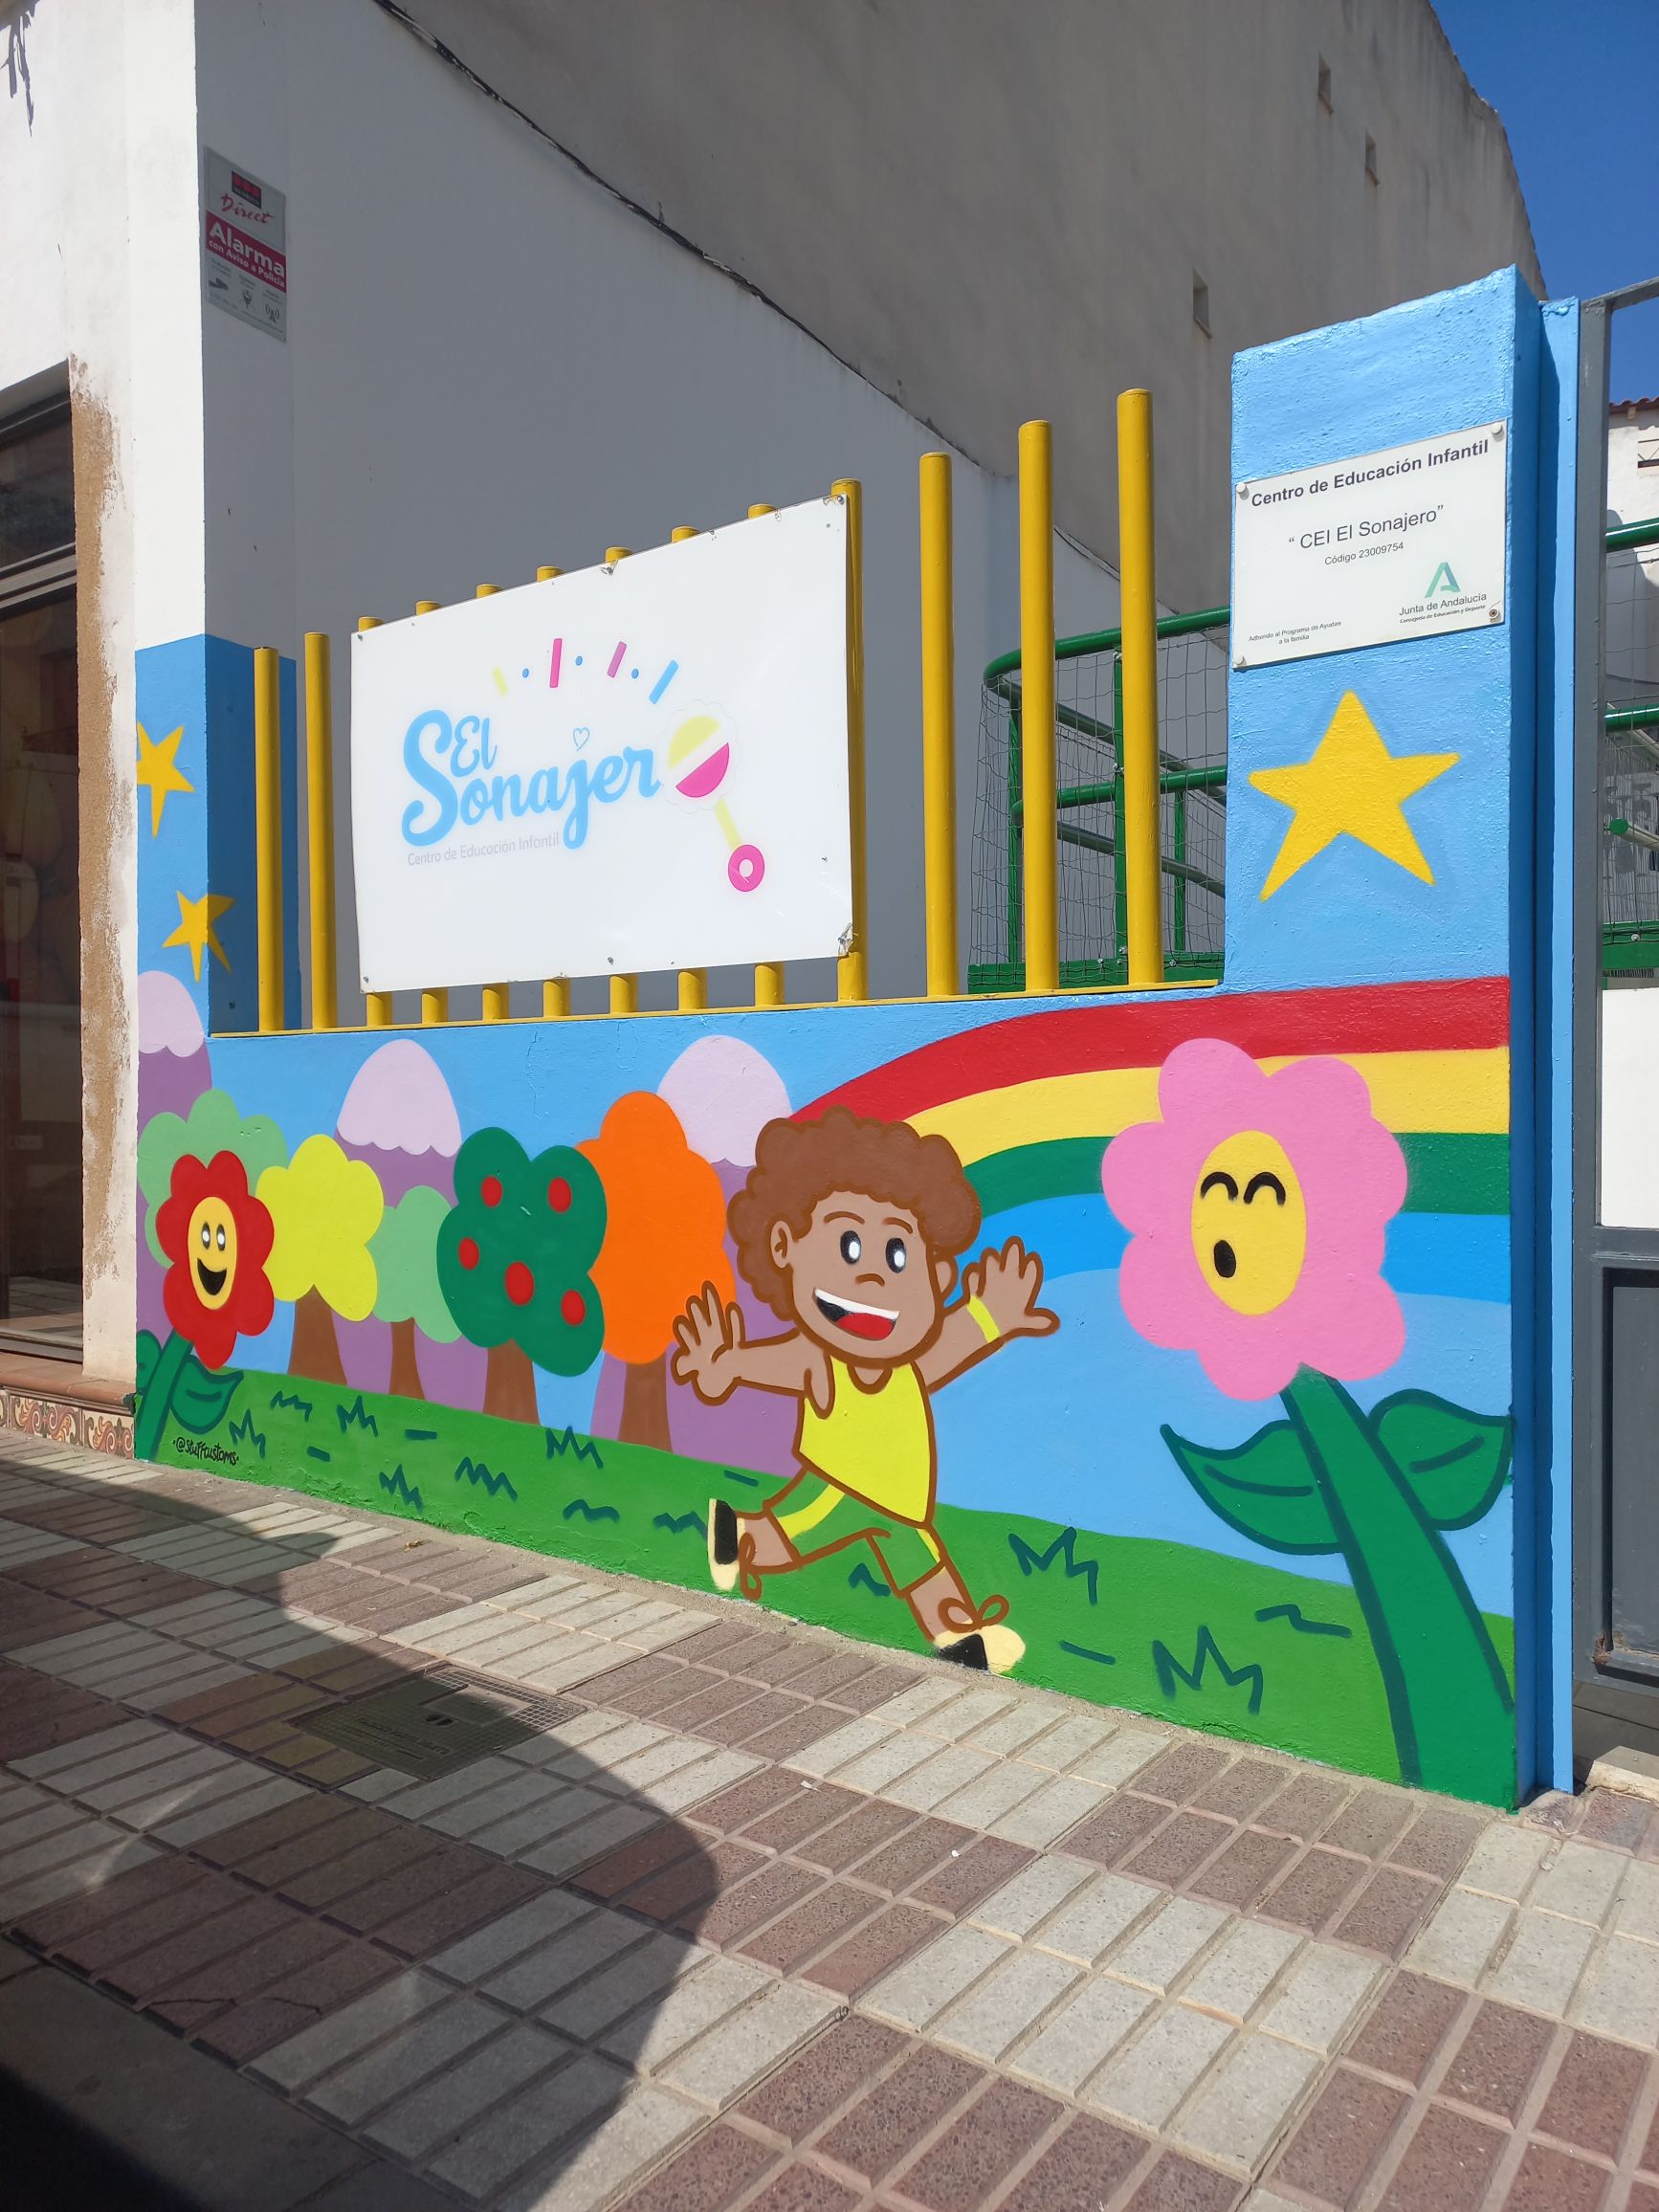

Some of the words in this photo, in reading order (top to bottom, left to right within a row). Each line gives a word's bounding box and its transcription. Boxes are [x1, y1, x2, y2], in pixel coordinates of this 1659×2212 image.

[220, 192, 275, 225] Direct
[208, 239, 225, 254] con
[226, 248, 249, 268] Aviso
[210, 221, 285, 278] Alarma
[1251, 485, 1305, 507] Centro
[1309, 479, 1329, 495] de
[1334, 458, 1422, 489] Educación
[1427, 439, 1489, 467] Infantil
[1337, 523, 1353, 542] El
[1324, 552, 1357, 565] Código
[1359, 542, 1405, 559] 23009754
[1399, 605, 1425, 616] Junta
[1427, 601, 1439, 610] de
[1440, 592, 1487, 608] Andalucía
[1281, 627, 1310, 636] Programa
[1319, 620, 1341, 630] Ayudas
[450, 715, 498, 778] El
[408, 851, 442, 866] Centro
[444, 847, 457, 861] de
[460, 837, 516, 858] Educación
[519, 832, 560, 851] Infantil
